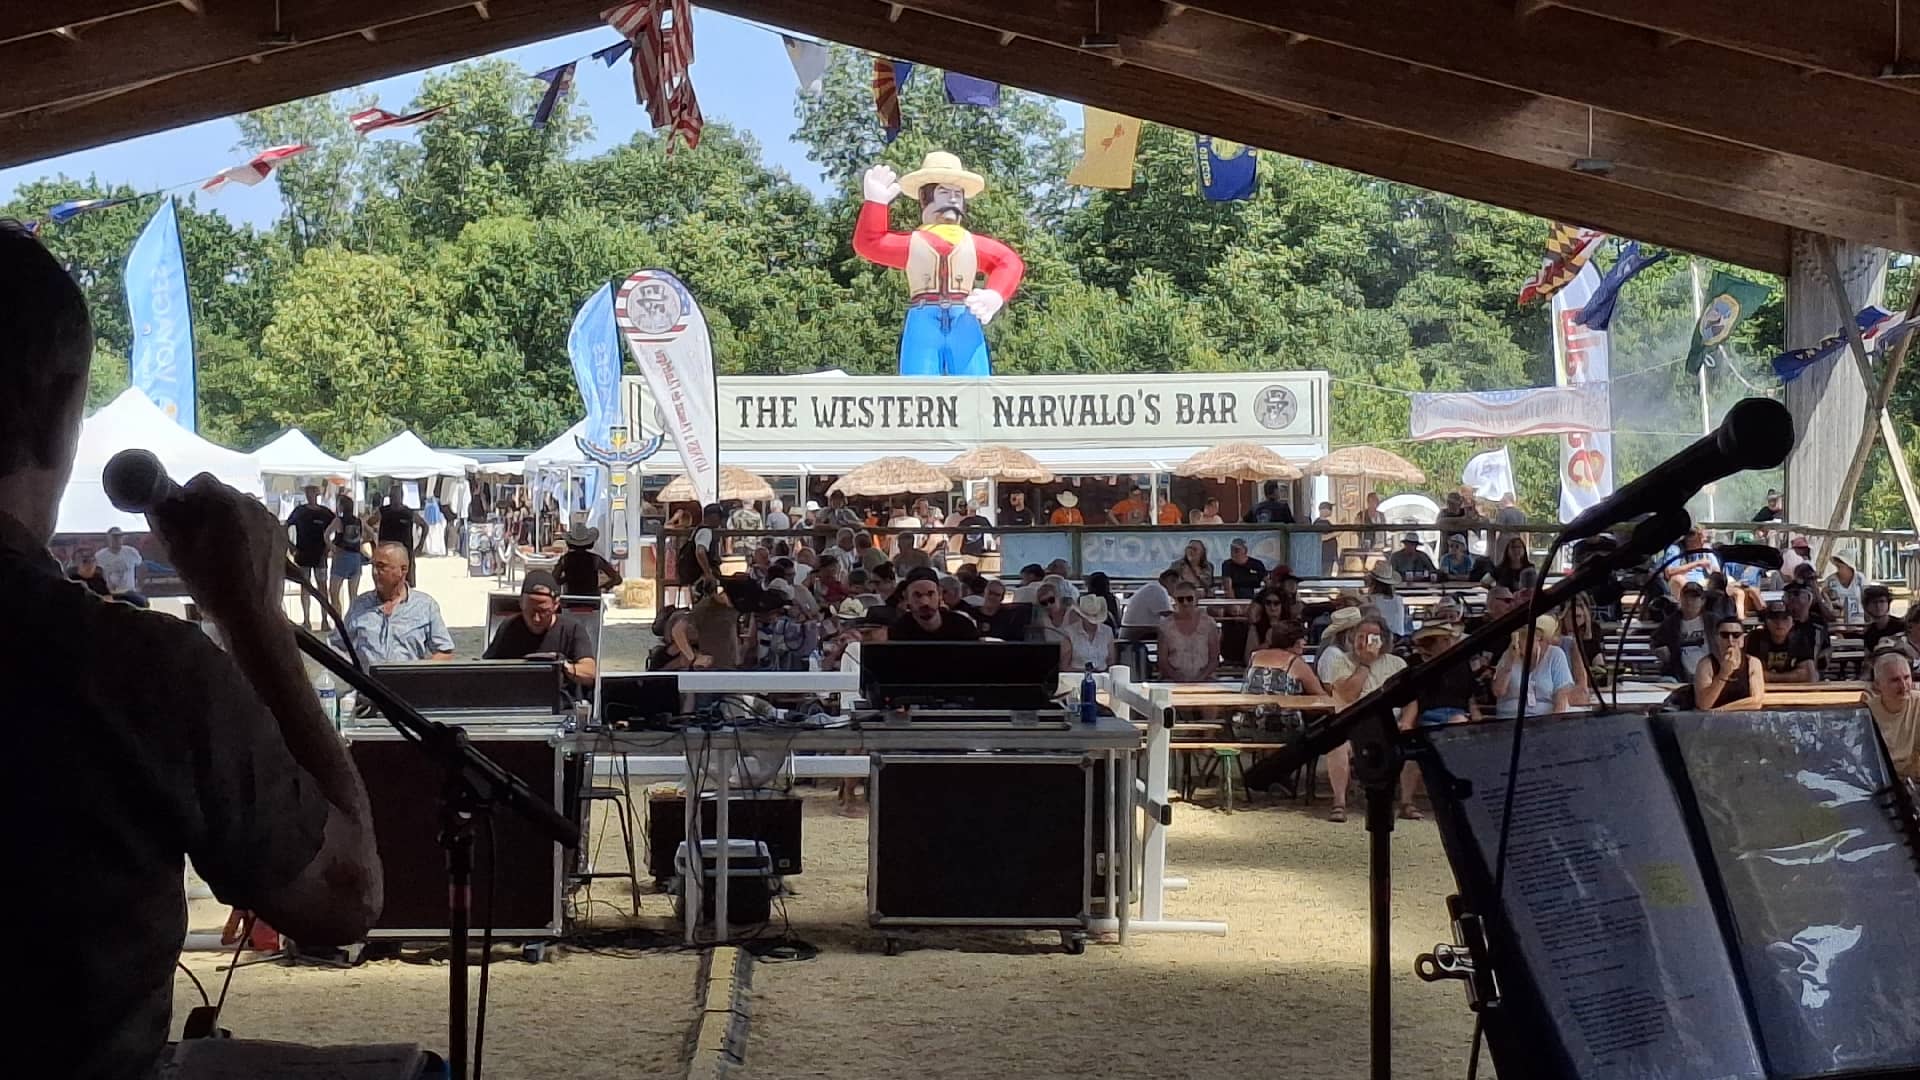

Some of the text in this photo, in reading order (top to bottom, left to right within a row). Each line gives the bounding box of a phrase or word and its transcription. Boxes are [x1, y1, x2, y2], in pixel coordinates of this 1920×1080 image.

[735, 388, 1238, 428] THE WESTERN NARVALO'S BAR
